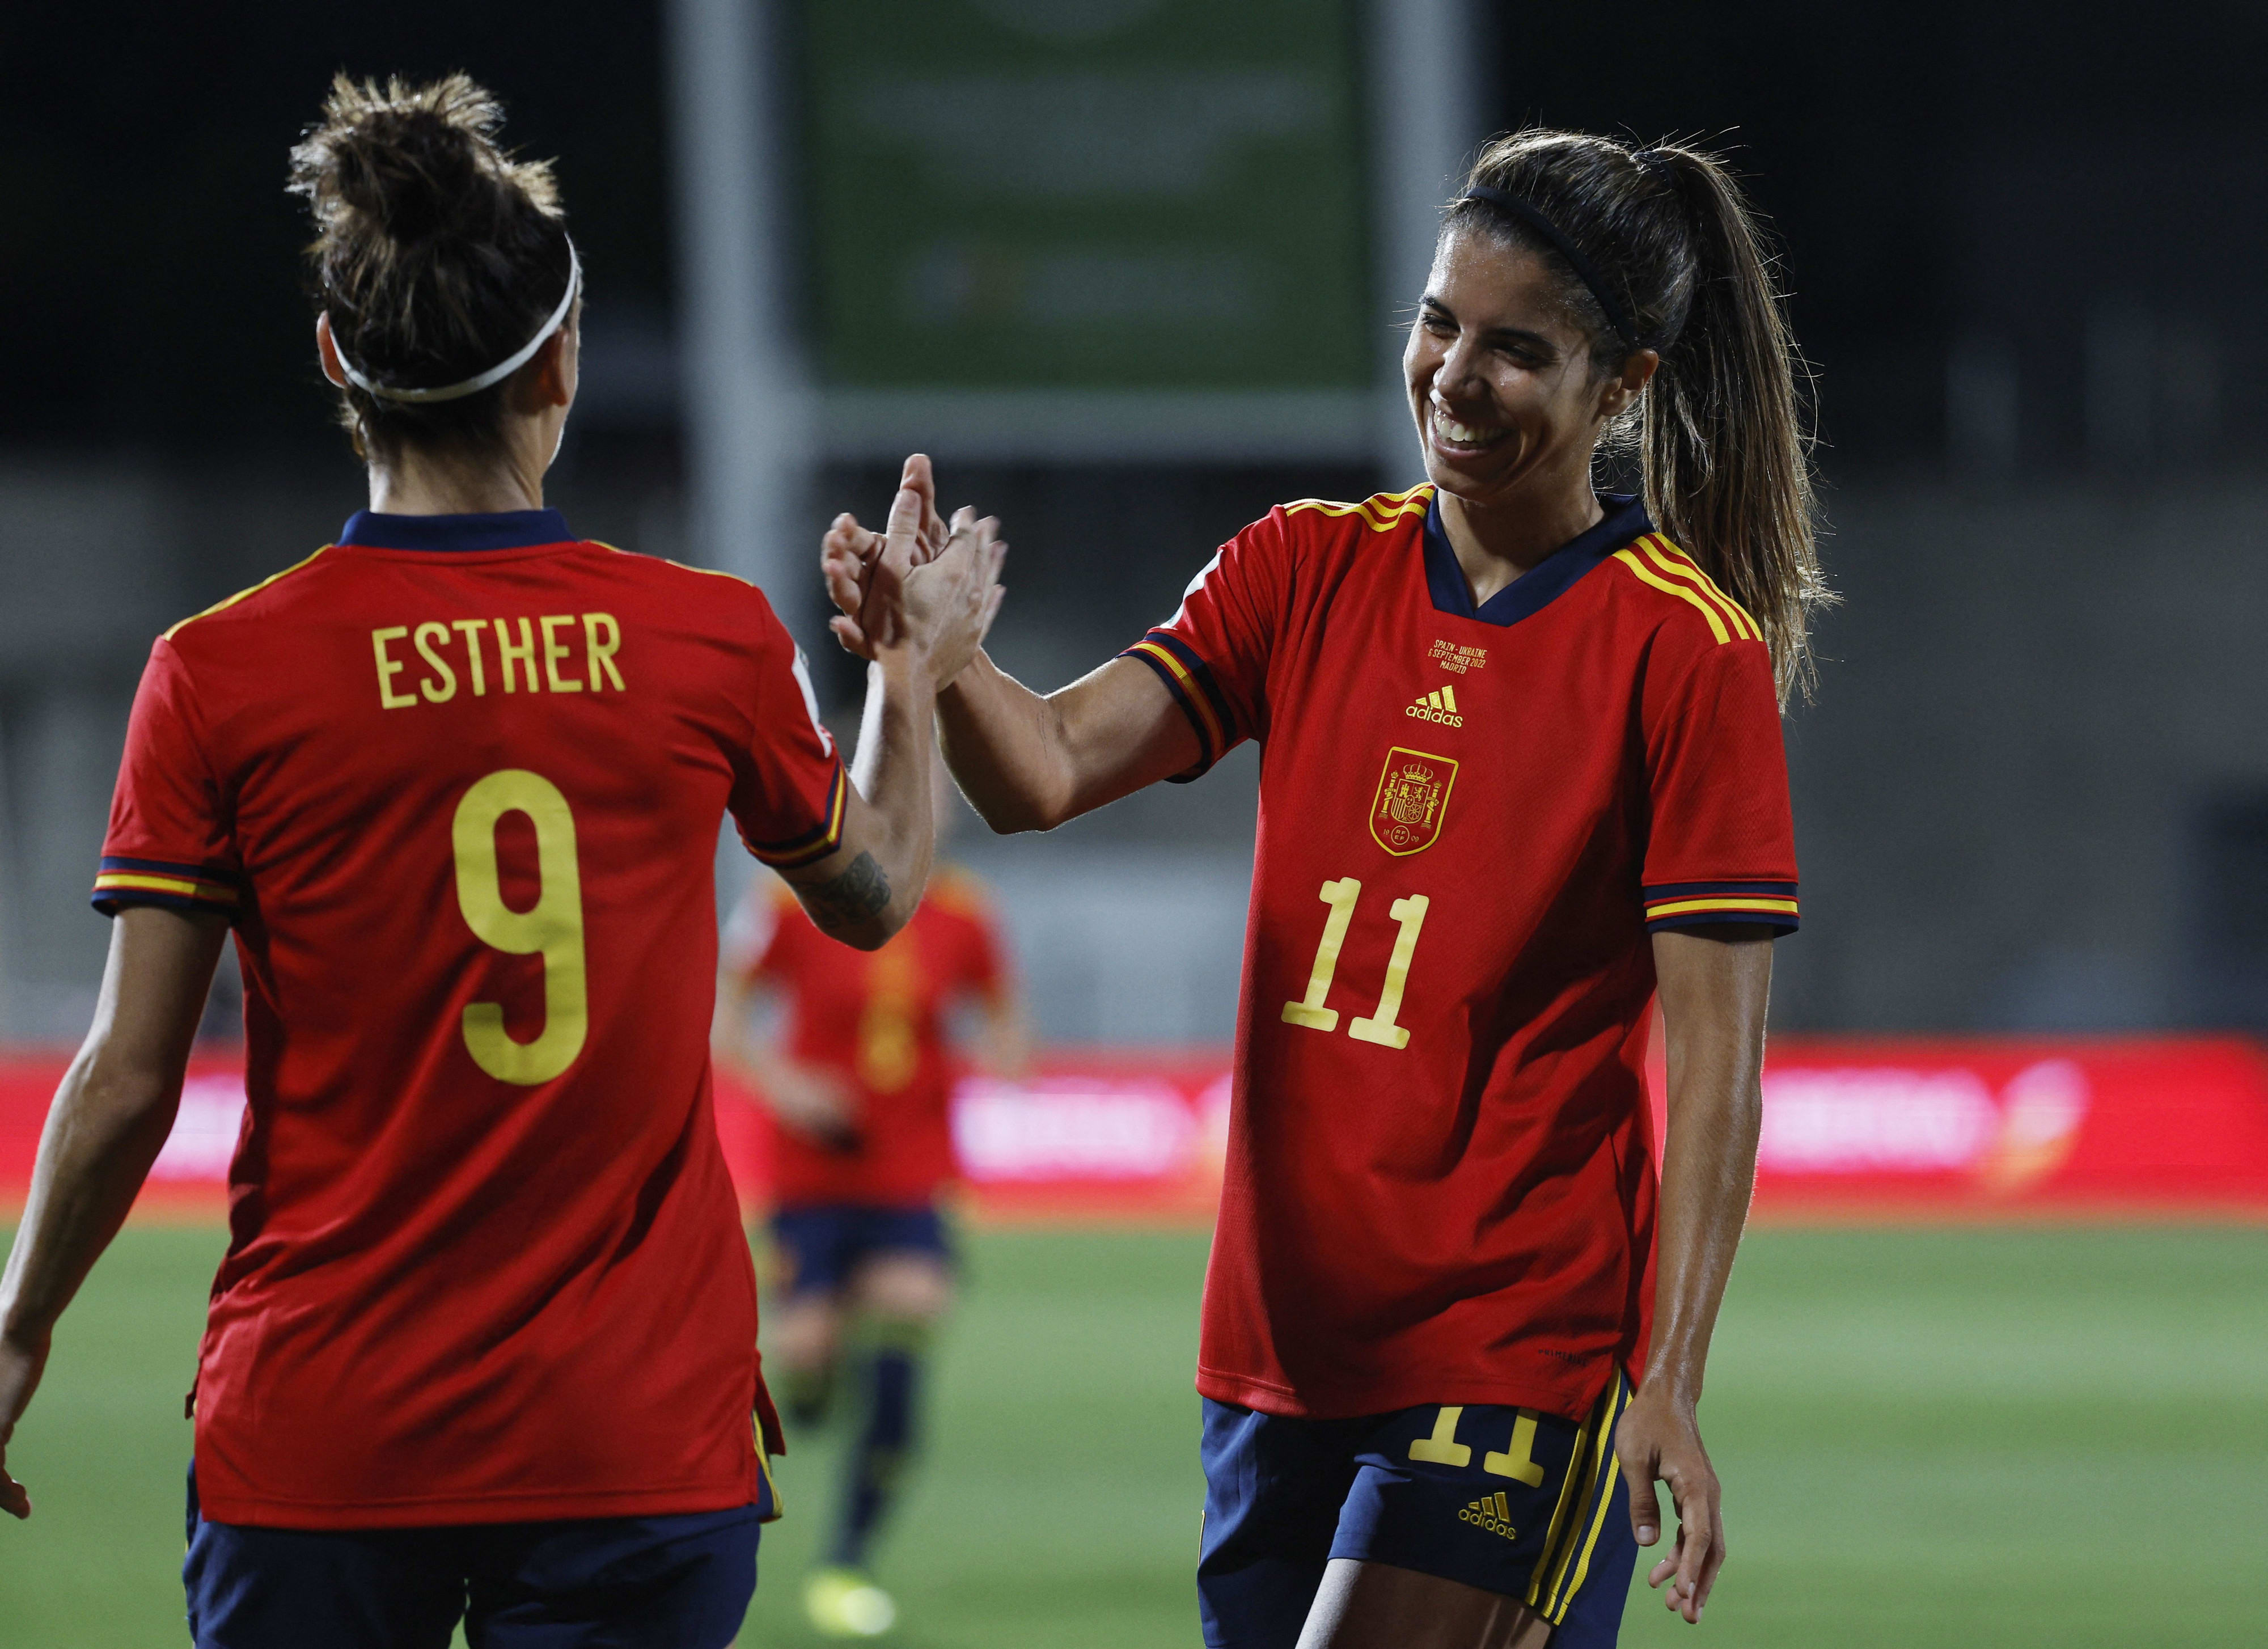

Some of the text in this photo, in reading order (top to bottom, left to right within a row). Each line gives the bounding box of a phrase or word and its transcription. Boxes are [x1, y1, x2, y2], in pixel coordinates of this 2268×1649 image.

[372, 612, 626, 709] ESTHER
[1428, 648, 1486, 668] 6 SEPTEMBER 2022
[1433, 640, 1455, 652] SPAIN
[1459, 646, 1487, 658] UKRAINE
[1440, 660, 1467, 674] MADRID
[1406, 705, 1463, 728] adidas
[452, 768, 588, 1086] 9
[1281, 877, 1429, 1050] 11
[1458, 1508, 1517, 1540] adidas
